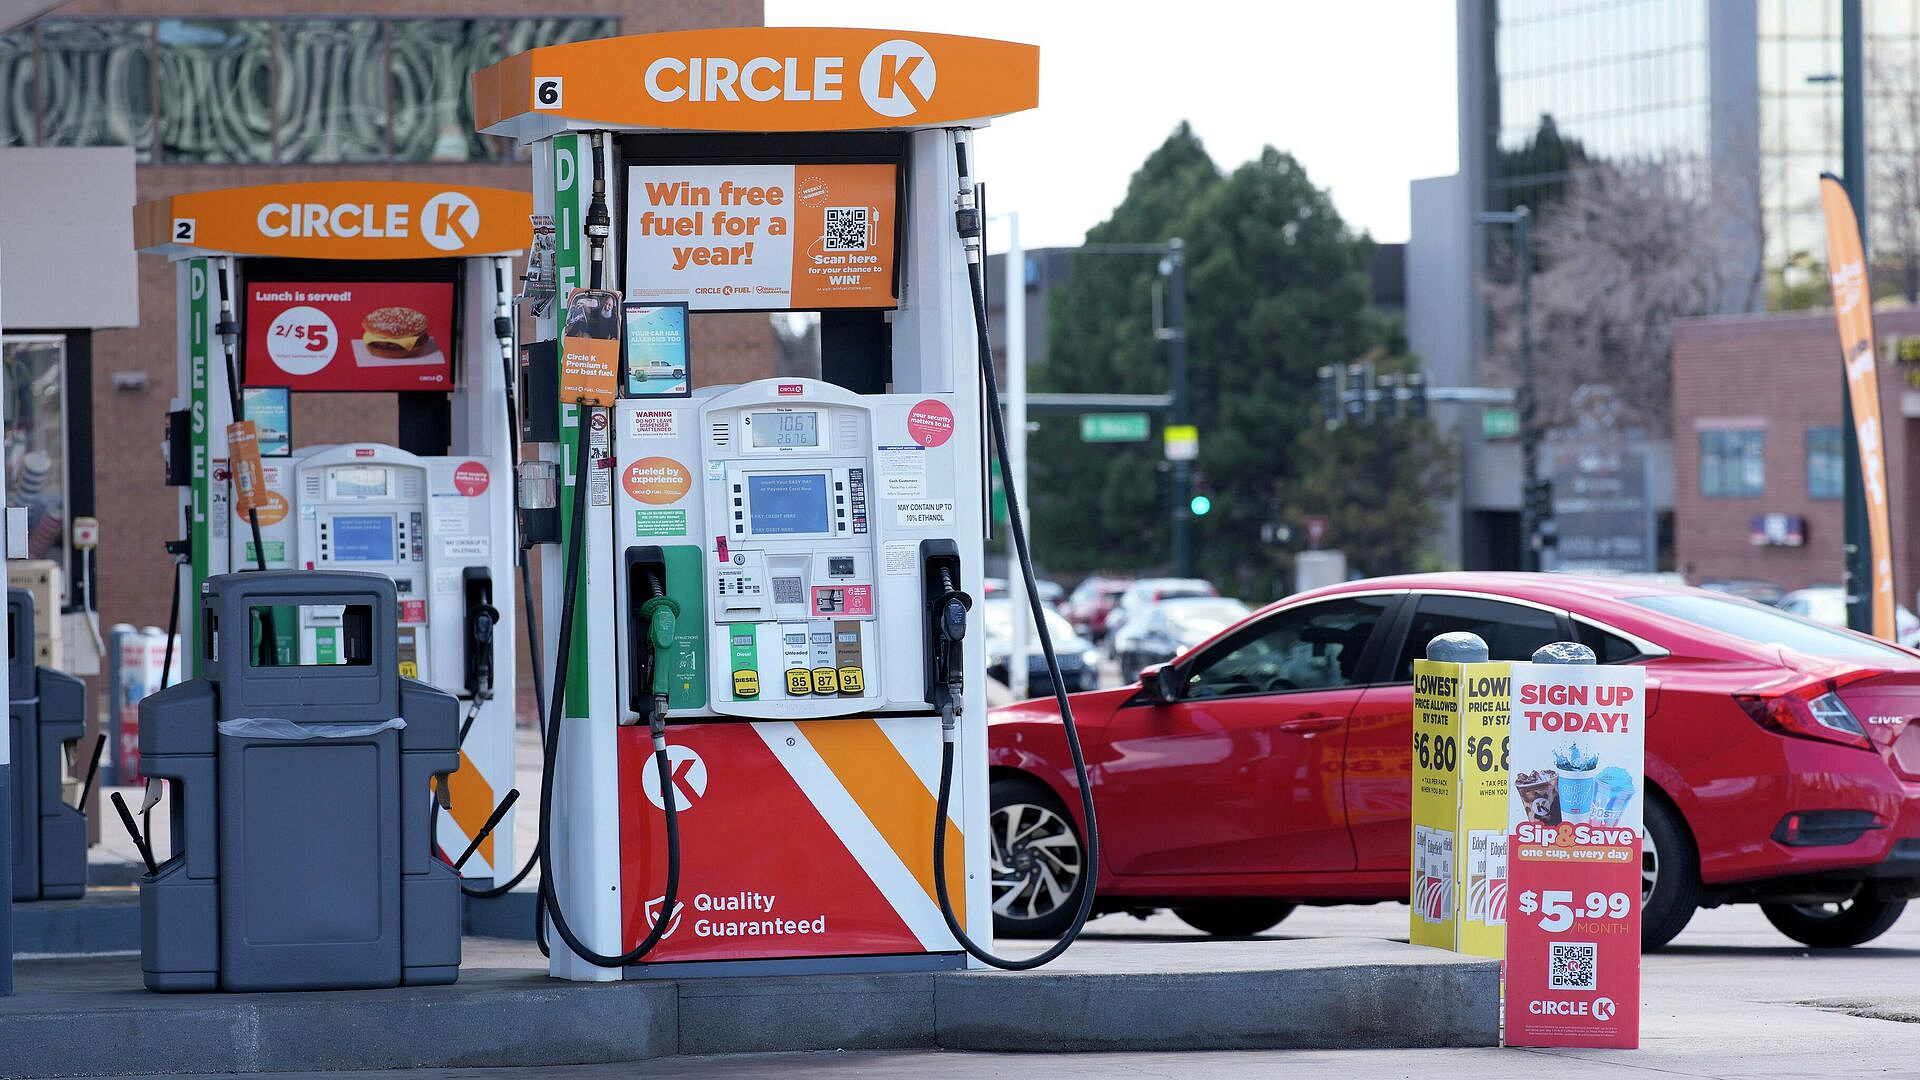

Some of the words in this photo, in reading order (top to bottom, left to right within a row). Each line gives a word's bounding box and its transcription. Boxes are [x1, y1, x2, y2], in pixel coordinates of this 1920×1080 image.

[644, 57, 844, 102] CIRCLE
[538, 80, 559, 105] 6
[645, 181, 710, 206] Win
[719, 181, 784, 206] free
[802, 184, 823, 195] WEEKLY
[257, 203, 408, 238] CIRCLE
[640, 211, 703, 236] fuel
[712, 211, 760, 236] for
[768, 216, 787, 236] a
[177, 221, 192, 240] 2
[672, 242, 754, 271] year!
[814, 254, 846, 264] Scan
[848, 254, 878, 264] here
[822, 267, 842, 275] your
[829, 275, 861, 285] WIN!
[256, 291, 293, 302] Lunch
[294, 291, 306, 302] is
[307, 291, 352, 302] served!
[695, 287, 721, 295] CIRCLE
[722, 285, 733, 296] K
[556, 149, 579, 487] DIEEL
[276, 324, 329, 352] 2/$5
[566, 353, 588, 362] Circle
[590, 354, 597, 362] K
[566, 360, 600, 370] Premium
[565, 367, 580, 375] our
[580, 368, 598, 376] best
[598, 368, 615, 377] fuel.
[192, 267, 205, 523] DIESEL
[745, 417, 751, 426] $
[910, 417, 934, 427] matters
[912, 411, 927, 419] your
[927, 413, 952, 423] security
[632, 467, 665, 475] Fueled
[666, 467, 680, 476] by
[631, 475, 684, 484] experience
[935, 503, 944, 511] UP
[943, 503, 953, 511] TO
[906, 514, 918, 522] 10%
[918, 513, 945, 522] ETHANOL
[792, 676, 807, 687] 85
[818, 675, 832, 686] 87
[844, 675, 858, 685] 91
[1415, 674, 1458, 697] LOWEST
[1469, 677, 1511, 697] LOW
[1519, 684, 1588, 706] SIGN
[1596, 686, 1634, 706] UP
[1415, 698, 1430, 710] PRICE
[1430, 699, 1458, 713] ALLOWED
[1468, 702, 1494, 712] PRICE
[1422, 713, 1430, 723] BY
[1430, 714, 1449, 726] STATE
[1482, 716, 1494, 726] BY
[1524, 711, 1629, 733] TODAY!
[1868, 716, 1904, 725] CIVIC
[1414, 731, 1457, 772] $6.80
[1496, 788, 1508, 796] YOU
[1536, 801, 1552, 814] K
[1427, 839, 1442, 856] Edgefield
[1521, 848, 1543, 858] one
[1546, 849, 1570, 860] cup,
[1572, 850, 1605, 861] every
[1607, 849, 1629, 861] day
[693, 891, 776, 913] Quality
[1518, 889, 1631, 933] $5.99
[694, 915, 826, 938] Guaranteed
[1568, 921, 1629, 935] /MONTH
[1529, 1000, 1588, 1016] CIRCLE
